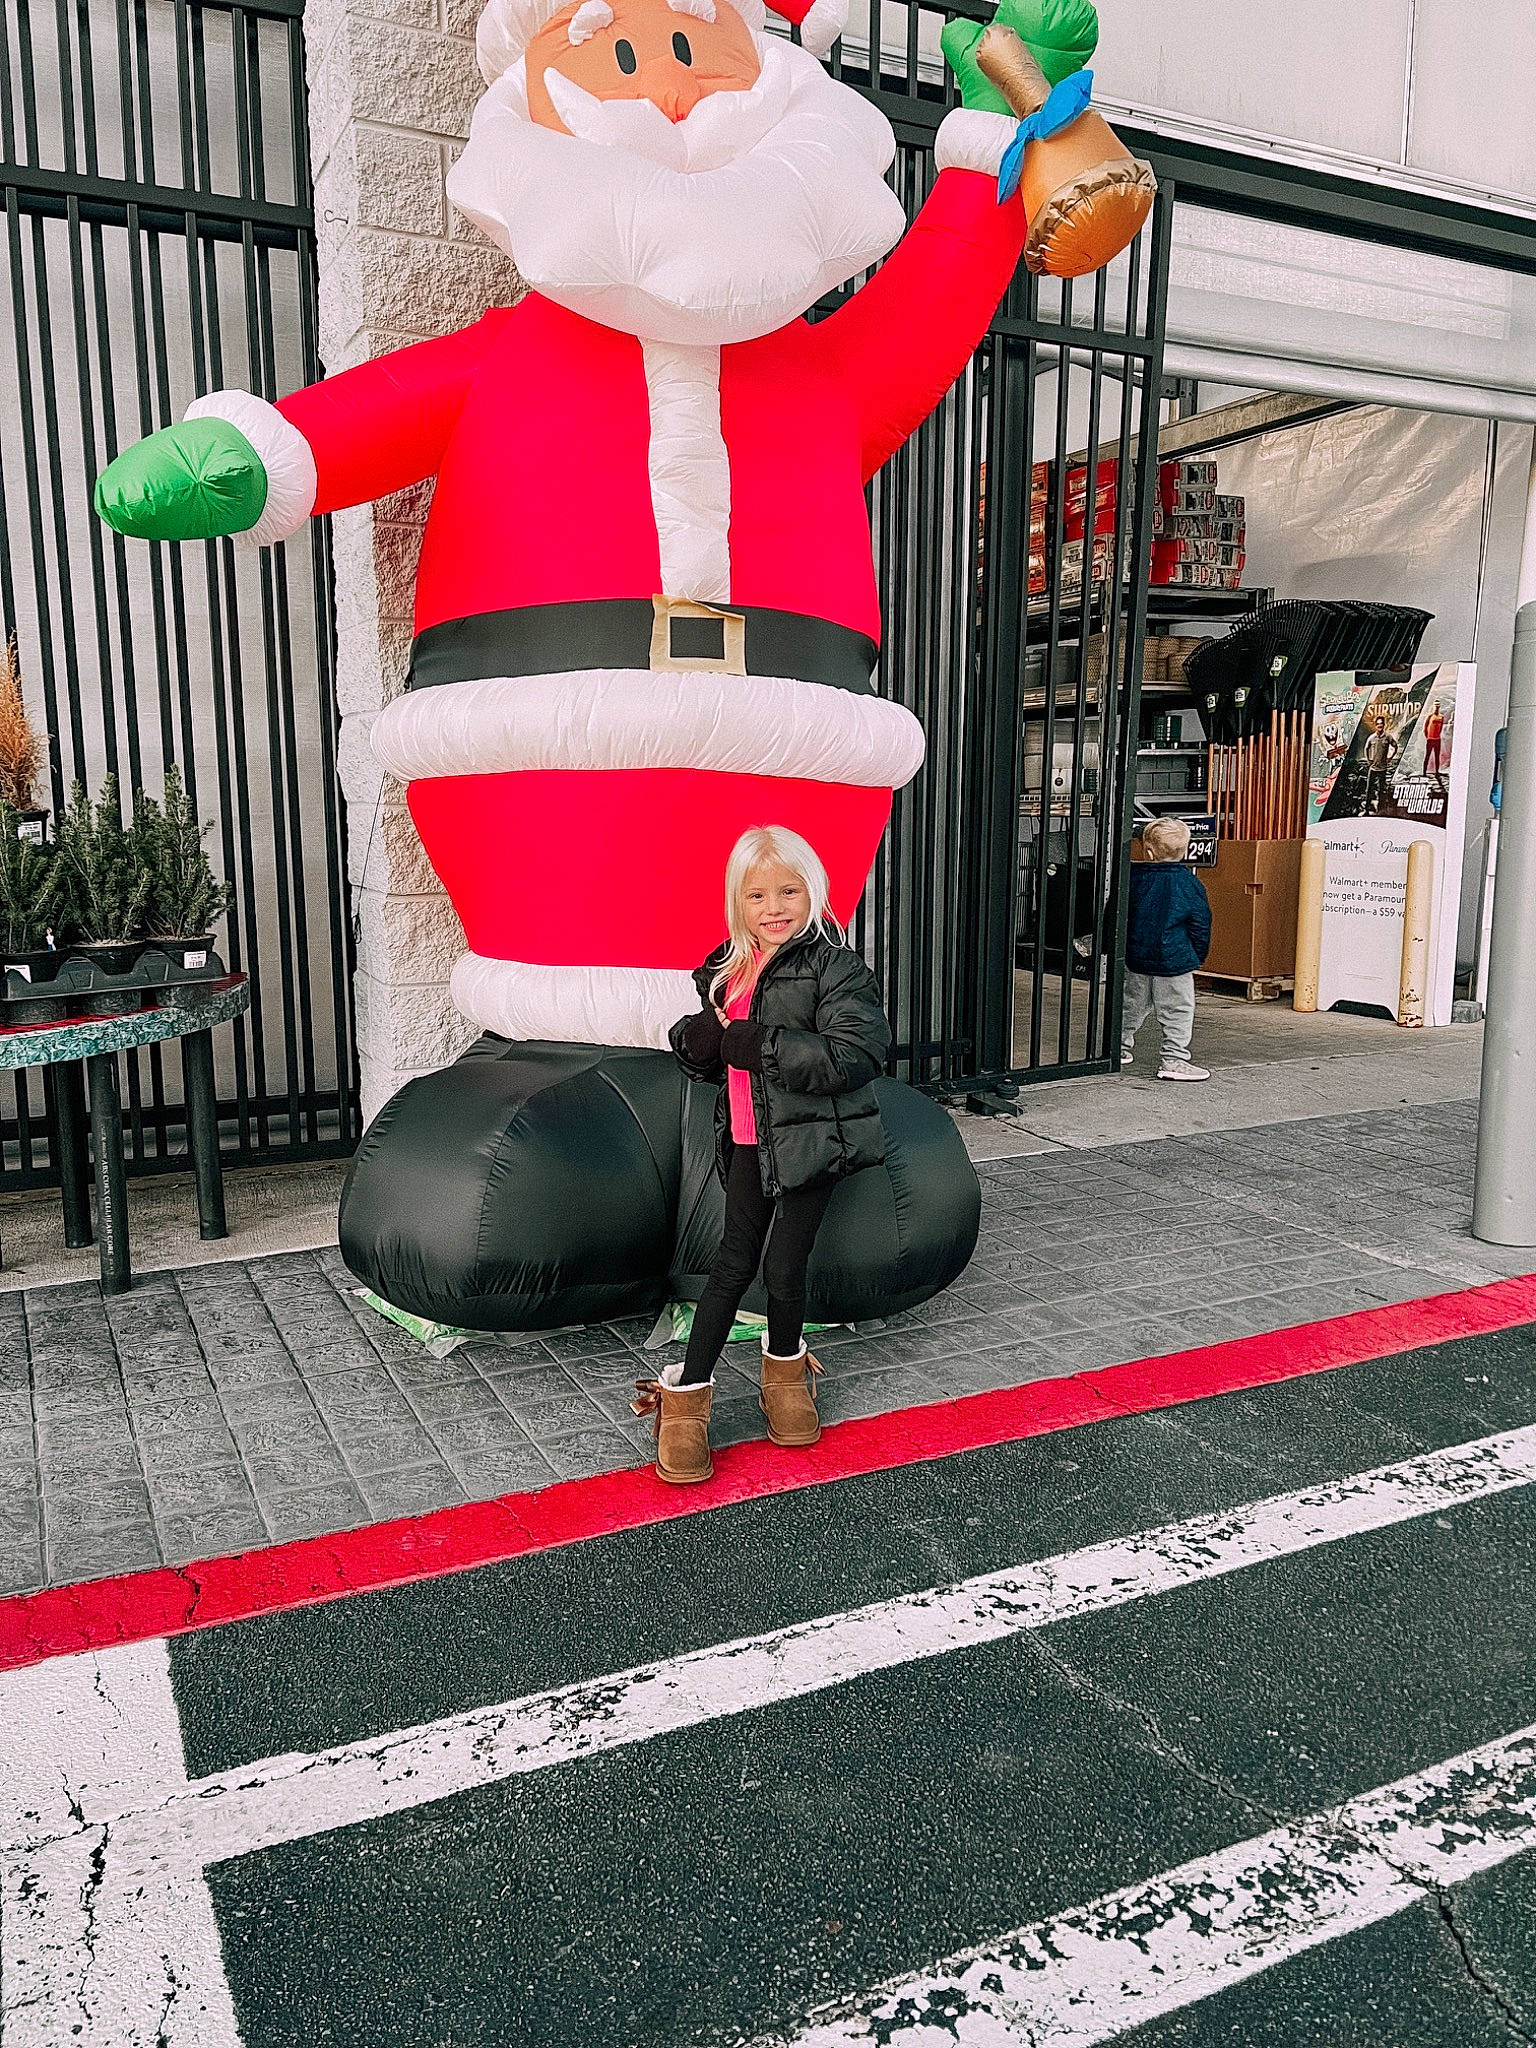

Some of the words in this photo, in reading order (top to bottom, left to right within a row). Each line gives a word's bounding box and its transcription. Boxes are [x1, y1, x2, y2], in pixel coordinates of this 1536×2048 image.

[1366, 702, 1422, 718] SURVIVOR
[1393, 784, 1432, 799] STRANGE
[1407, 799, 1444, 814] WORLDS
[1196, 823, 1209, 831] Price
[1323, 840, 1360, 851] almart+
[1330, 876, 1368, 887] Walmart+
[1371, 881, 1407, 890] member
[1342, 893, 1355, 902] get
[1365, 892, 1406, 904] Paramoun
[1380, 907, 1395, 918] $59
